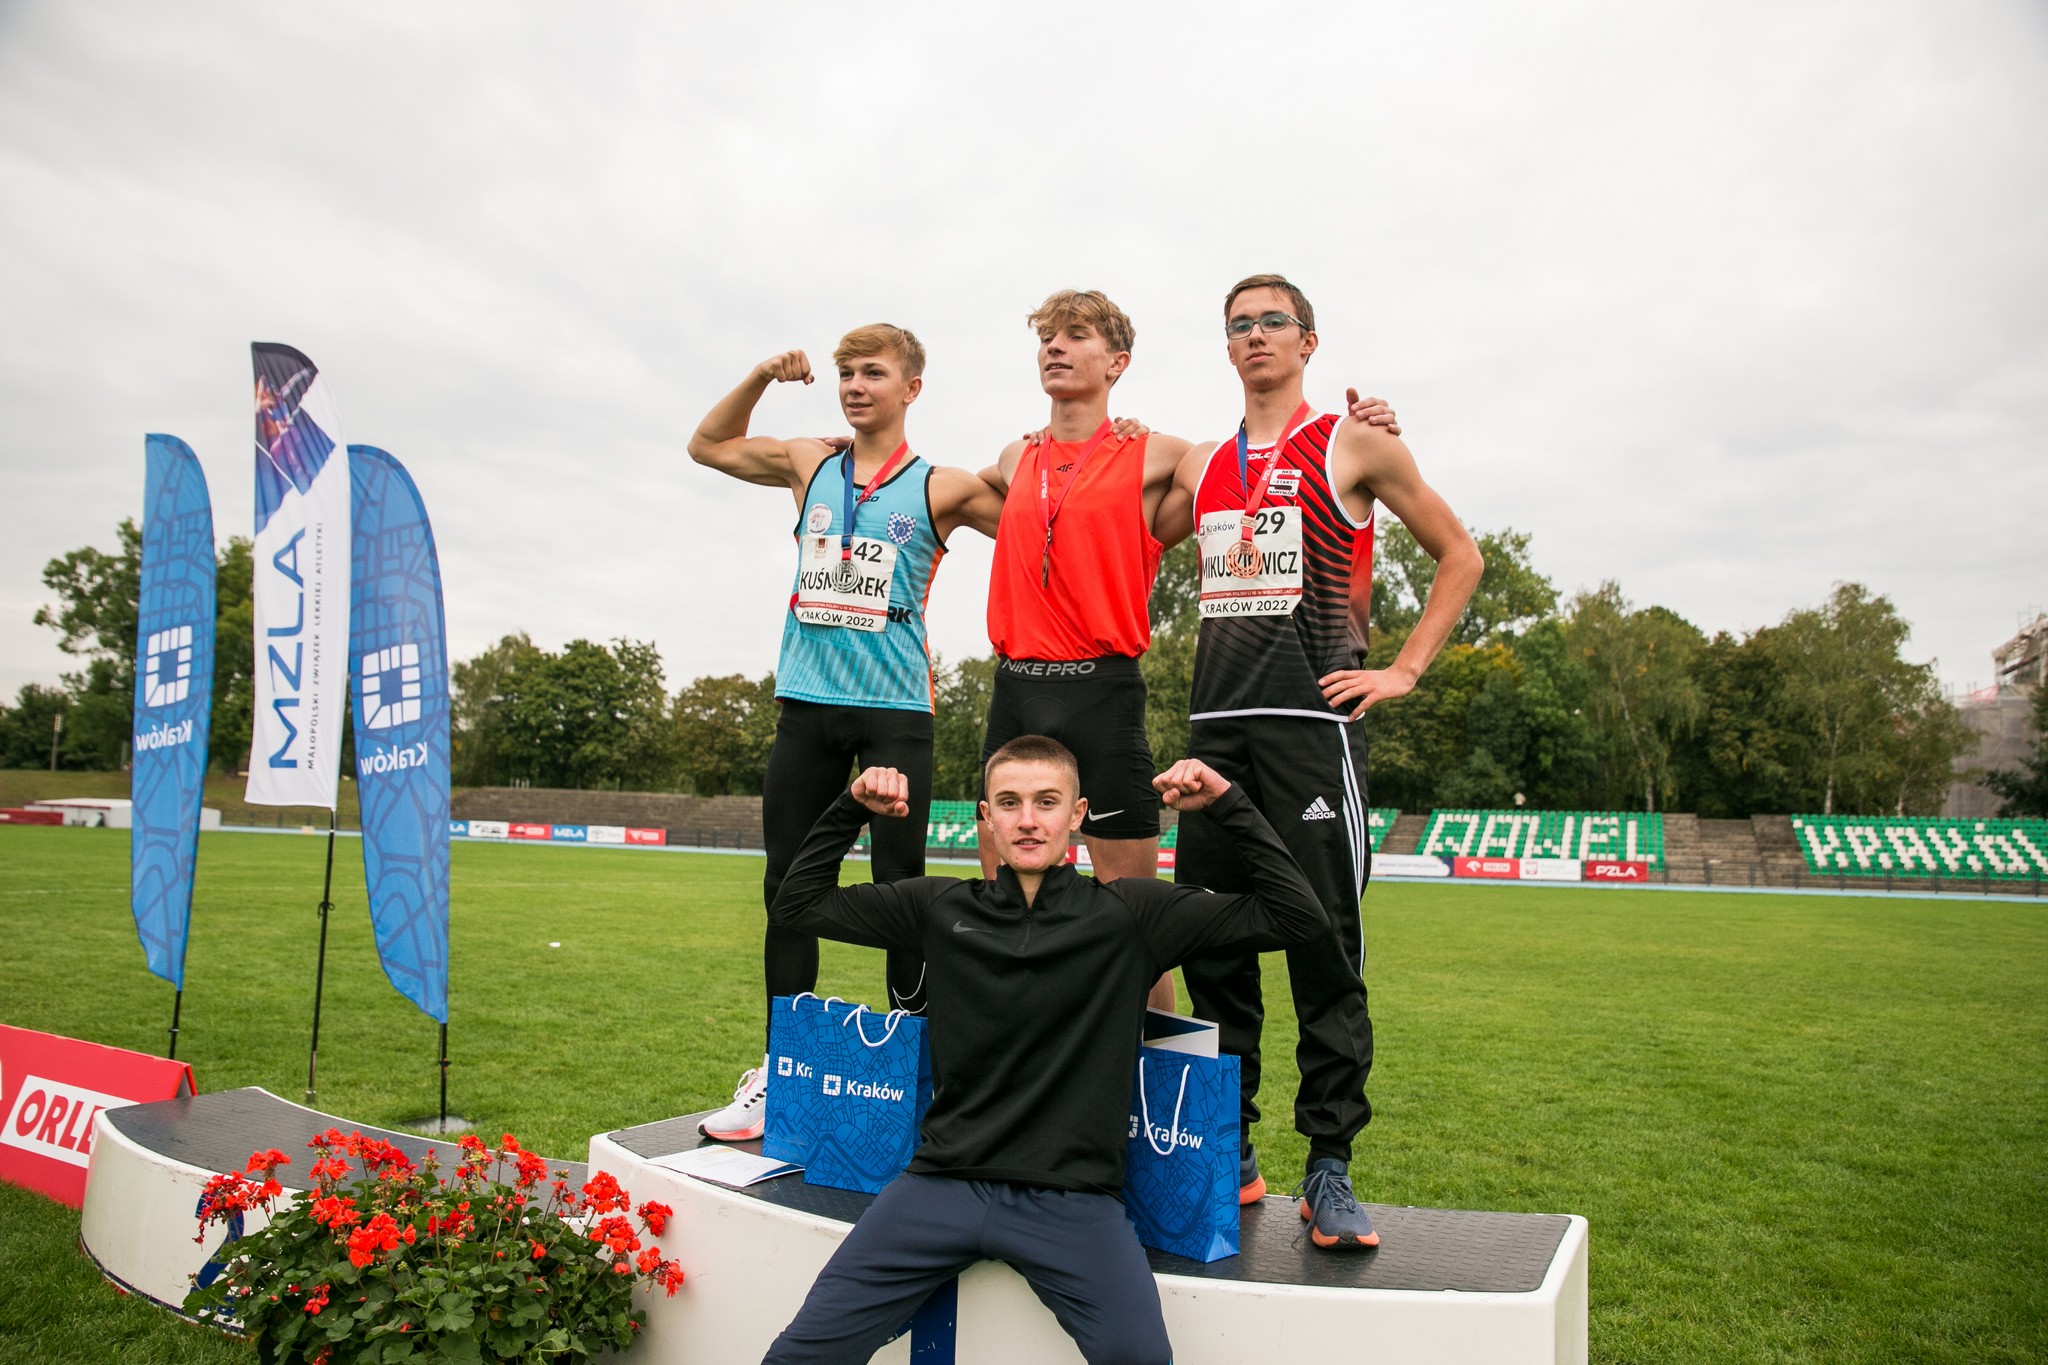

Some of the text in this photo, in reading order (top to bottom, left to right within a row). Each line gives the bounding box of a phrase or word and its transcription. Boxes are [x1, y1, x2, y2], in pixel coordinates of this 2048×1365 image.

[1056, 462, 1074, 473] 4F
[1206, 521, 1236, 533] Kraków
[1254, 511, 1286, 535] 29
[315, 522, 323, 575] ATLETYKI
[853, 541, 883, 563] 42
[314, 582, 323, 626] LEKKIEJ
[1205, 599, 1288, 614] KRAKÓW 2022
[801, 610, 875, 628] KRAKÓW 2022
[267, 526, 306, 769] MZLA
[1001, 658, 1096, 676] NIKE PRO
[307, 693, 319, 770] MAŁOPOLSKI
[1302, 811, 1336, 820] adidas
[1595, 865, 1638, 878] PZLA
[846, 1080, 905, 1102] Kraków
[1144, 1122, 1203, 1150] Kraków
